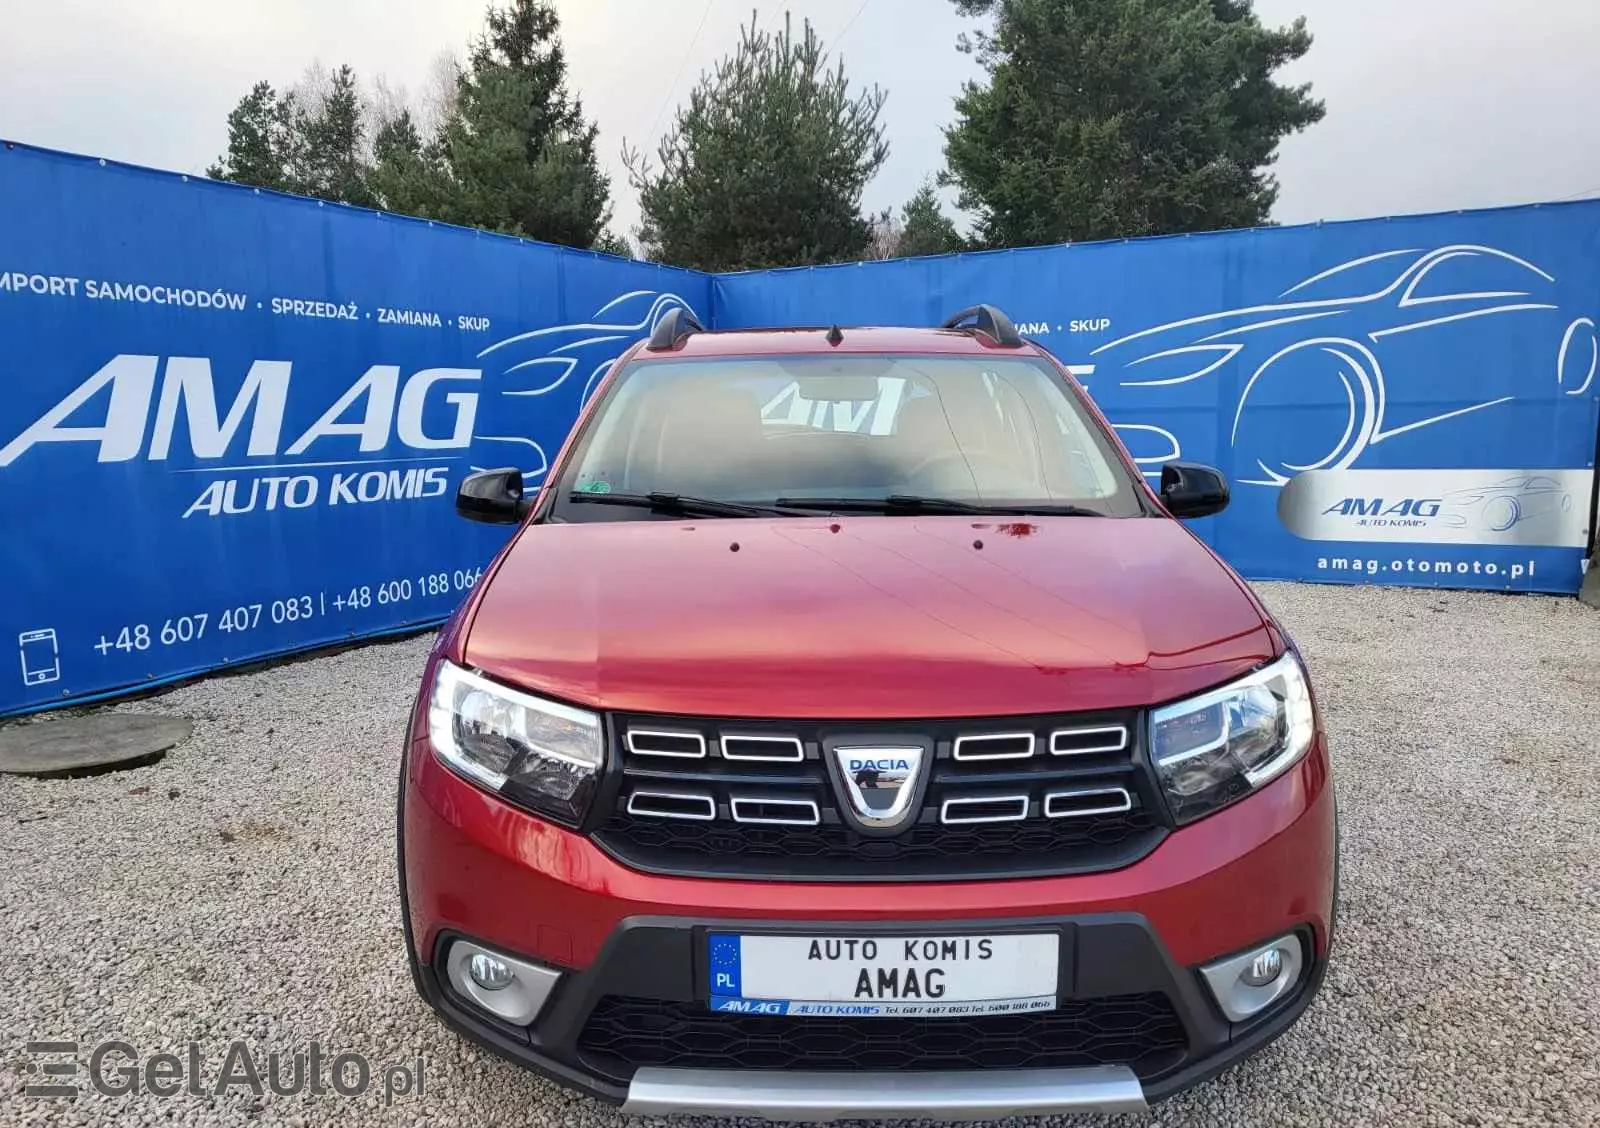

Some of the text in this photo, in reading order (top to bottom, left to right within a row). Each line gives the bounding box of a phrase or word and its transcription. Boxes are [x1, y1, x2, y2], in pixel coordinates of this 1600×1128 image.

[85, 279, 247, 311] SAMOCHODÓW
[271, 298, 359, 320] SPRZEDAŻ
[377, 308, 442, 328] ZAMIANA
[457, 315, 491, 331] SKUP
[1069, 318, 1111, 332] SKUP
[181, 467, 449, 519] AUTO KOMIS
[1317, 555, 1535, 579] amag.otomoto.pl
[94, 624, 151, 656] +48
[160, 613, 209, 645] 607
[218, 604, 263, 633] 407
[271, 595, 313, 624] 083
[332, 587, 372, 612] +48
[377, 578, 412, 605] 600
[418, 573, 449, 597] 188
[850, 759, 909, 771] DACIA
[807, 938, 993, 961] AUTO KOMIS
[716, 973, 735, 988] PL
[854, 968, 946, 998] AMAG
[795, 1005, 833, 1014] AUTO
[836, 1005, 880, 1014] KOMIS
